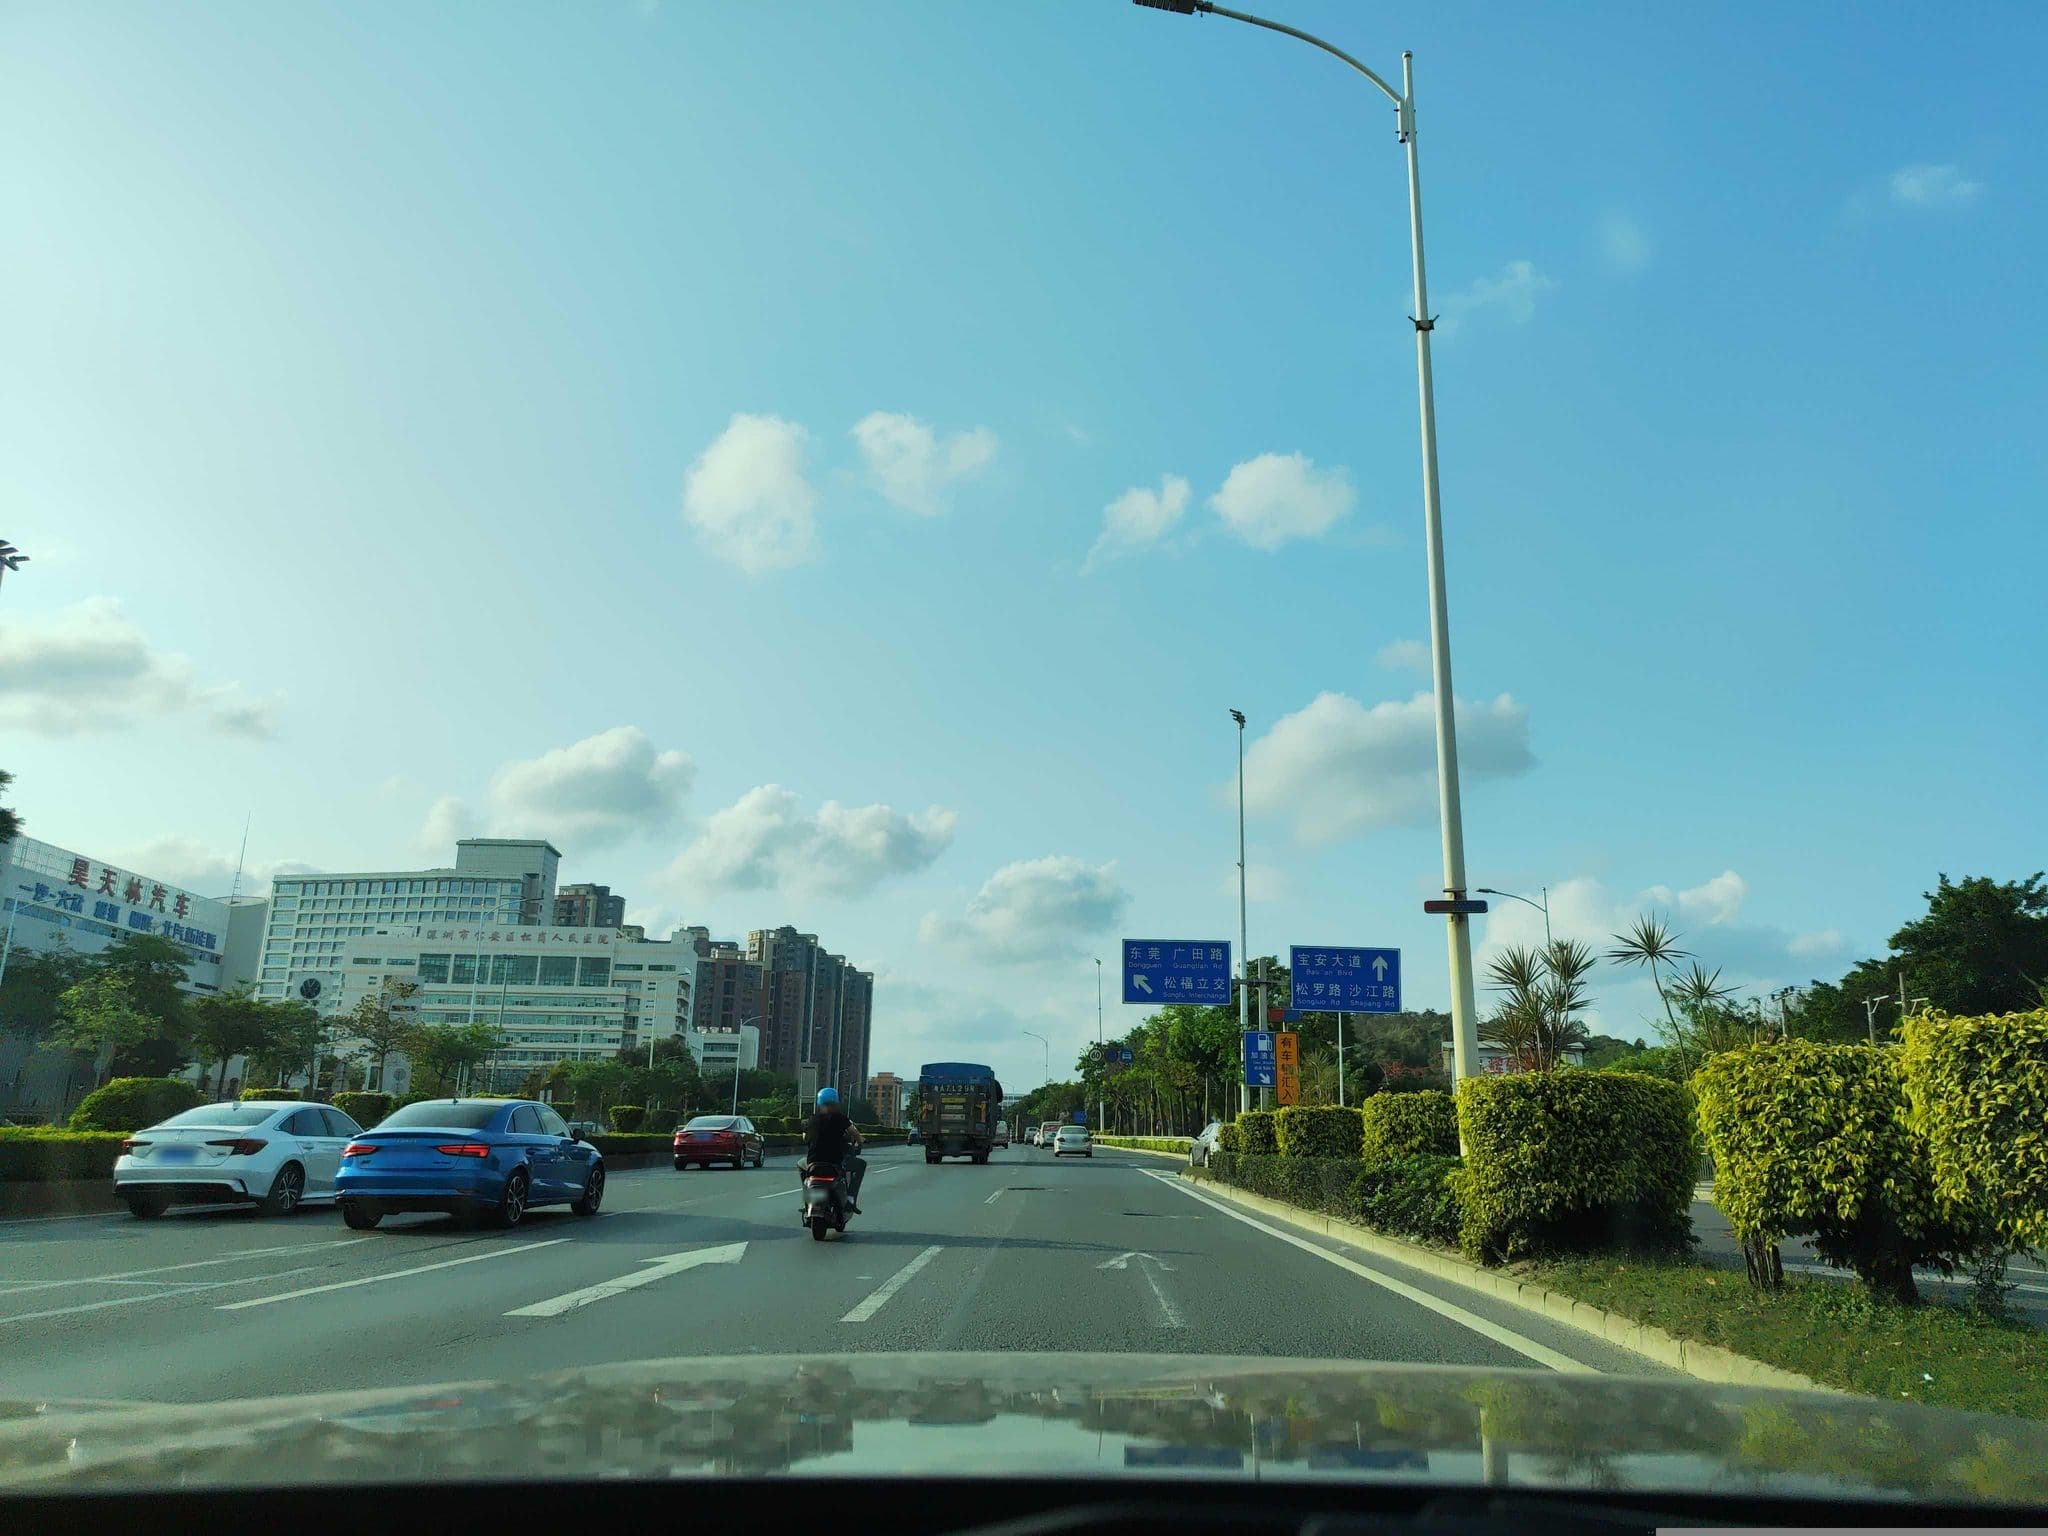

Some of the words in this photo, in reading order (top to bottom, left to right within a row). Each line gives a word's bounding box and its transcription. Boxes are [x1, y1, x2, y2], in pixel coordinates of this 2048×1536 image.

[1130, 947, 1161, 960] 东莞
[1173, 947, 1223, 961] 广田路
[1297, 953, 1362, 968] 宝安大道
[1163, 976, 1225, 990] 松福立交
[1295, 982, 1342, 997] 松罗路
[1349, 984, 1396, 998] 沙江路
